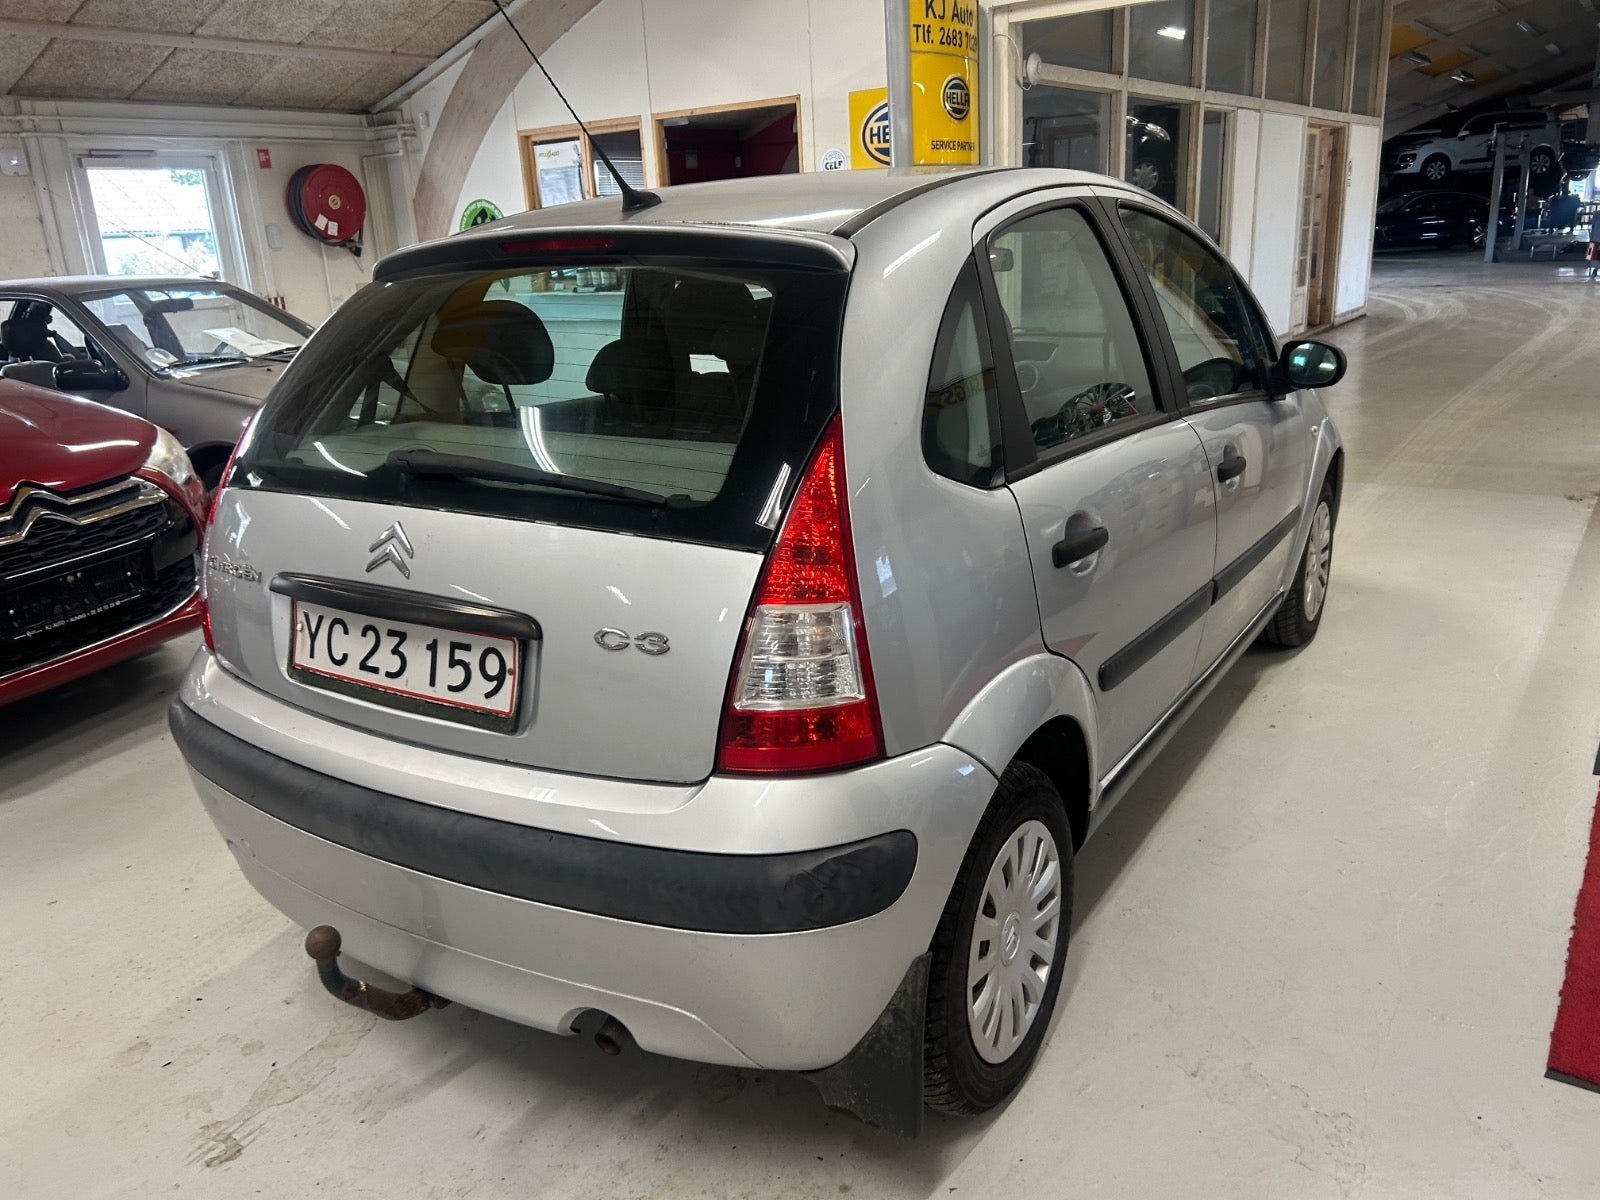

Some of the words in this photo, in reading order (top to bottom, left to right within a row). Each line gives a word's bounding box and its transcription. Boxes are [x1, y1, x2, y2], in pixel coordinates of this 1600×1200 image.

[925, 0, 945, 20] KJ
[951, 0, 974, 28] Auto
[913, 24, 934, 44] Tlf.
[939, 26, 963, 48] 2683
[946, 91, 970, 107] HELLA
[930, 140, 956, 151] SERVICE
[593, 627, 671, 656] C3
[303, 610, 350, 667] YC
[358, 624, 408, 679] 23
[425, 638, 508, 700] 159
